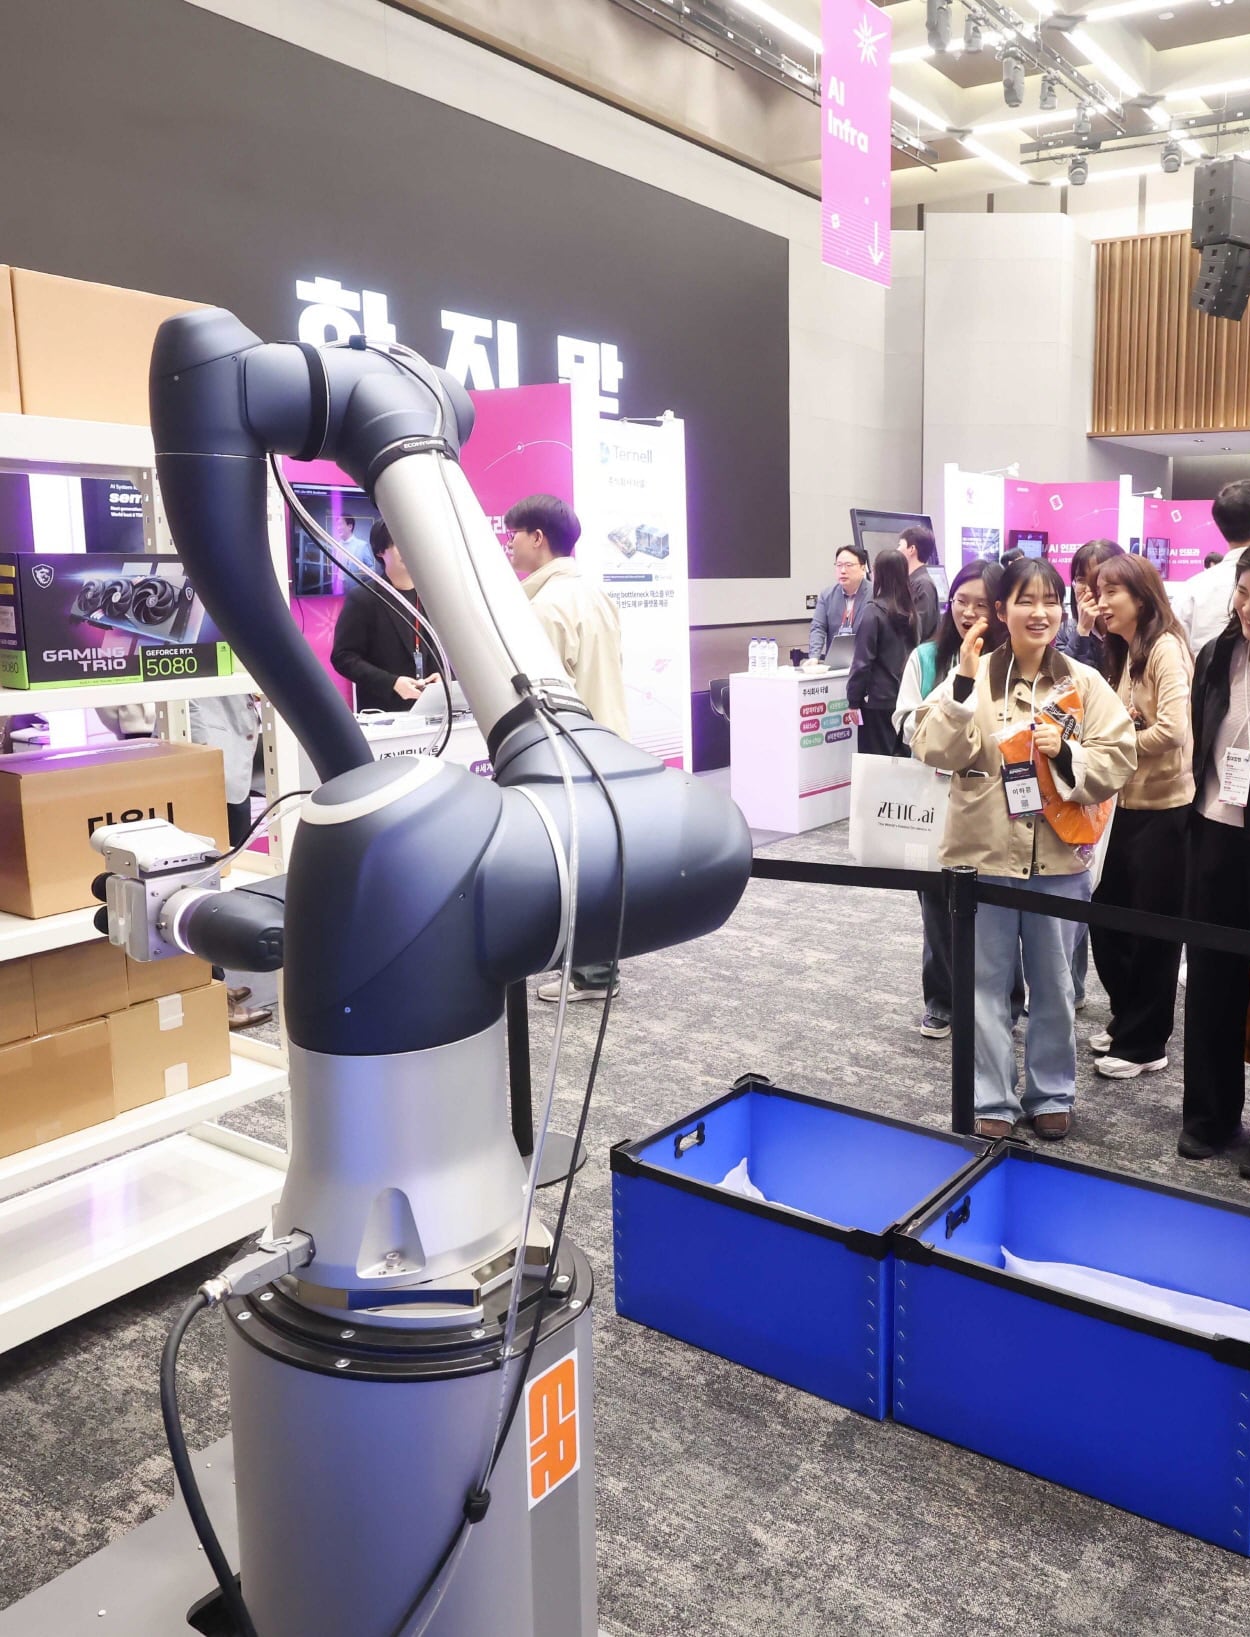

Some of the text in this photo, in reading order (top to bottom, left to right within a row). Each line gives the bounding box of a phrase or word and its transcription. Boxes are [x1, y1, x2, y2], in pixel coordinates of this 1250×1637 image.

[828, 75, 845, 107] AI
[827, 108, 869, 154] Infra
[42, 646, 126, 663] GAMING
[145, 647, 194, 657] GEFORCE RTX
[78, 658, 127, 673] TRIO
[146, 656, 198, 677] 5080
